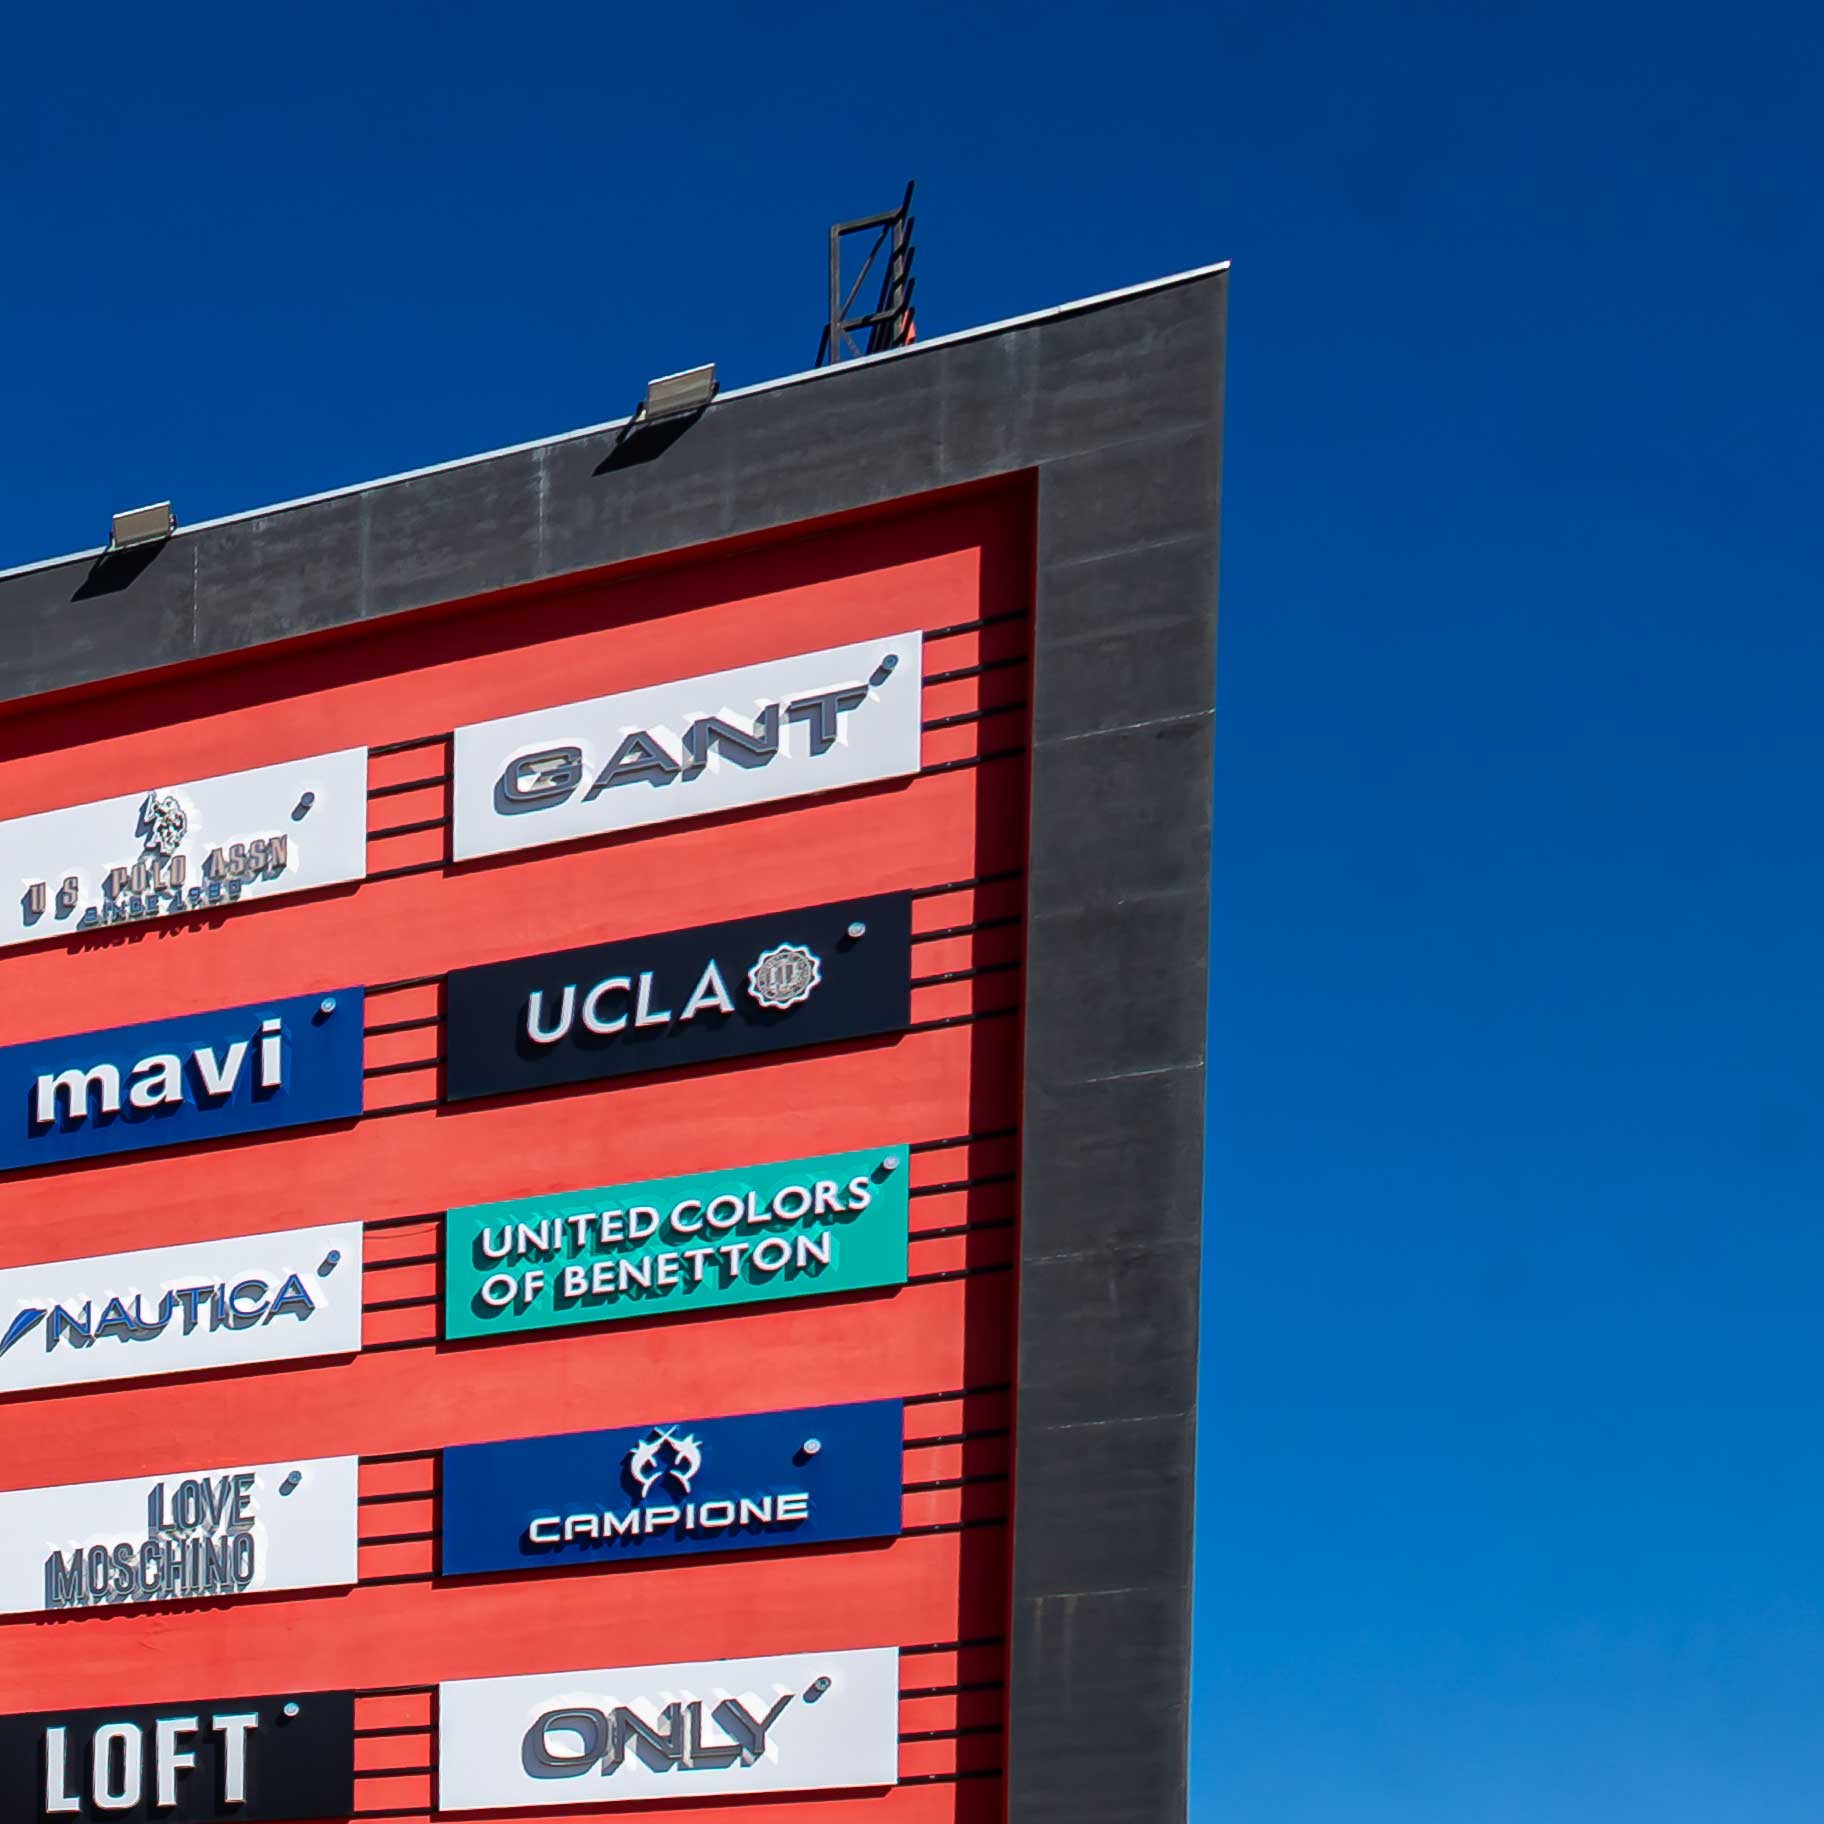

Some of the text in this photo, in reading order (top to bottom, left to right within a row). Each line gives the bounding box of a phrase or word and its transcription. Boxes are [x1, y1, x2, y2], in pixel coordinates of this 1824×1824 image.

[499, 682, 870, 806] GANT
[105, 855, 186, 898] POLO
[204, 834, 288, 885] ASSN
[527, 959, 736, 1044] UCLA
[35, 1019, 284, 1126] mavi
[480, 1174, 872, 1261] UNITED COLORS
[480, 1229, 833, 1309] OF BENETTON
[46, 1273, 318, 1350] NAUTICA
[149, 1472, 255, 1533] LOVE
[529, 1491, 810, 1544] CAMPIONE
[45, 1531, 256, 1606] MOSCHINO
[44, 1711, 259, 1815] LOFT
[522, 1692, 793, 1777] ONLY
